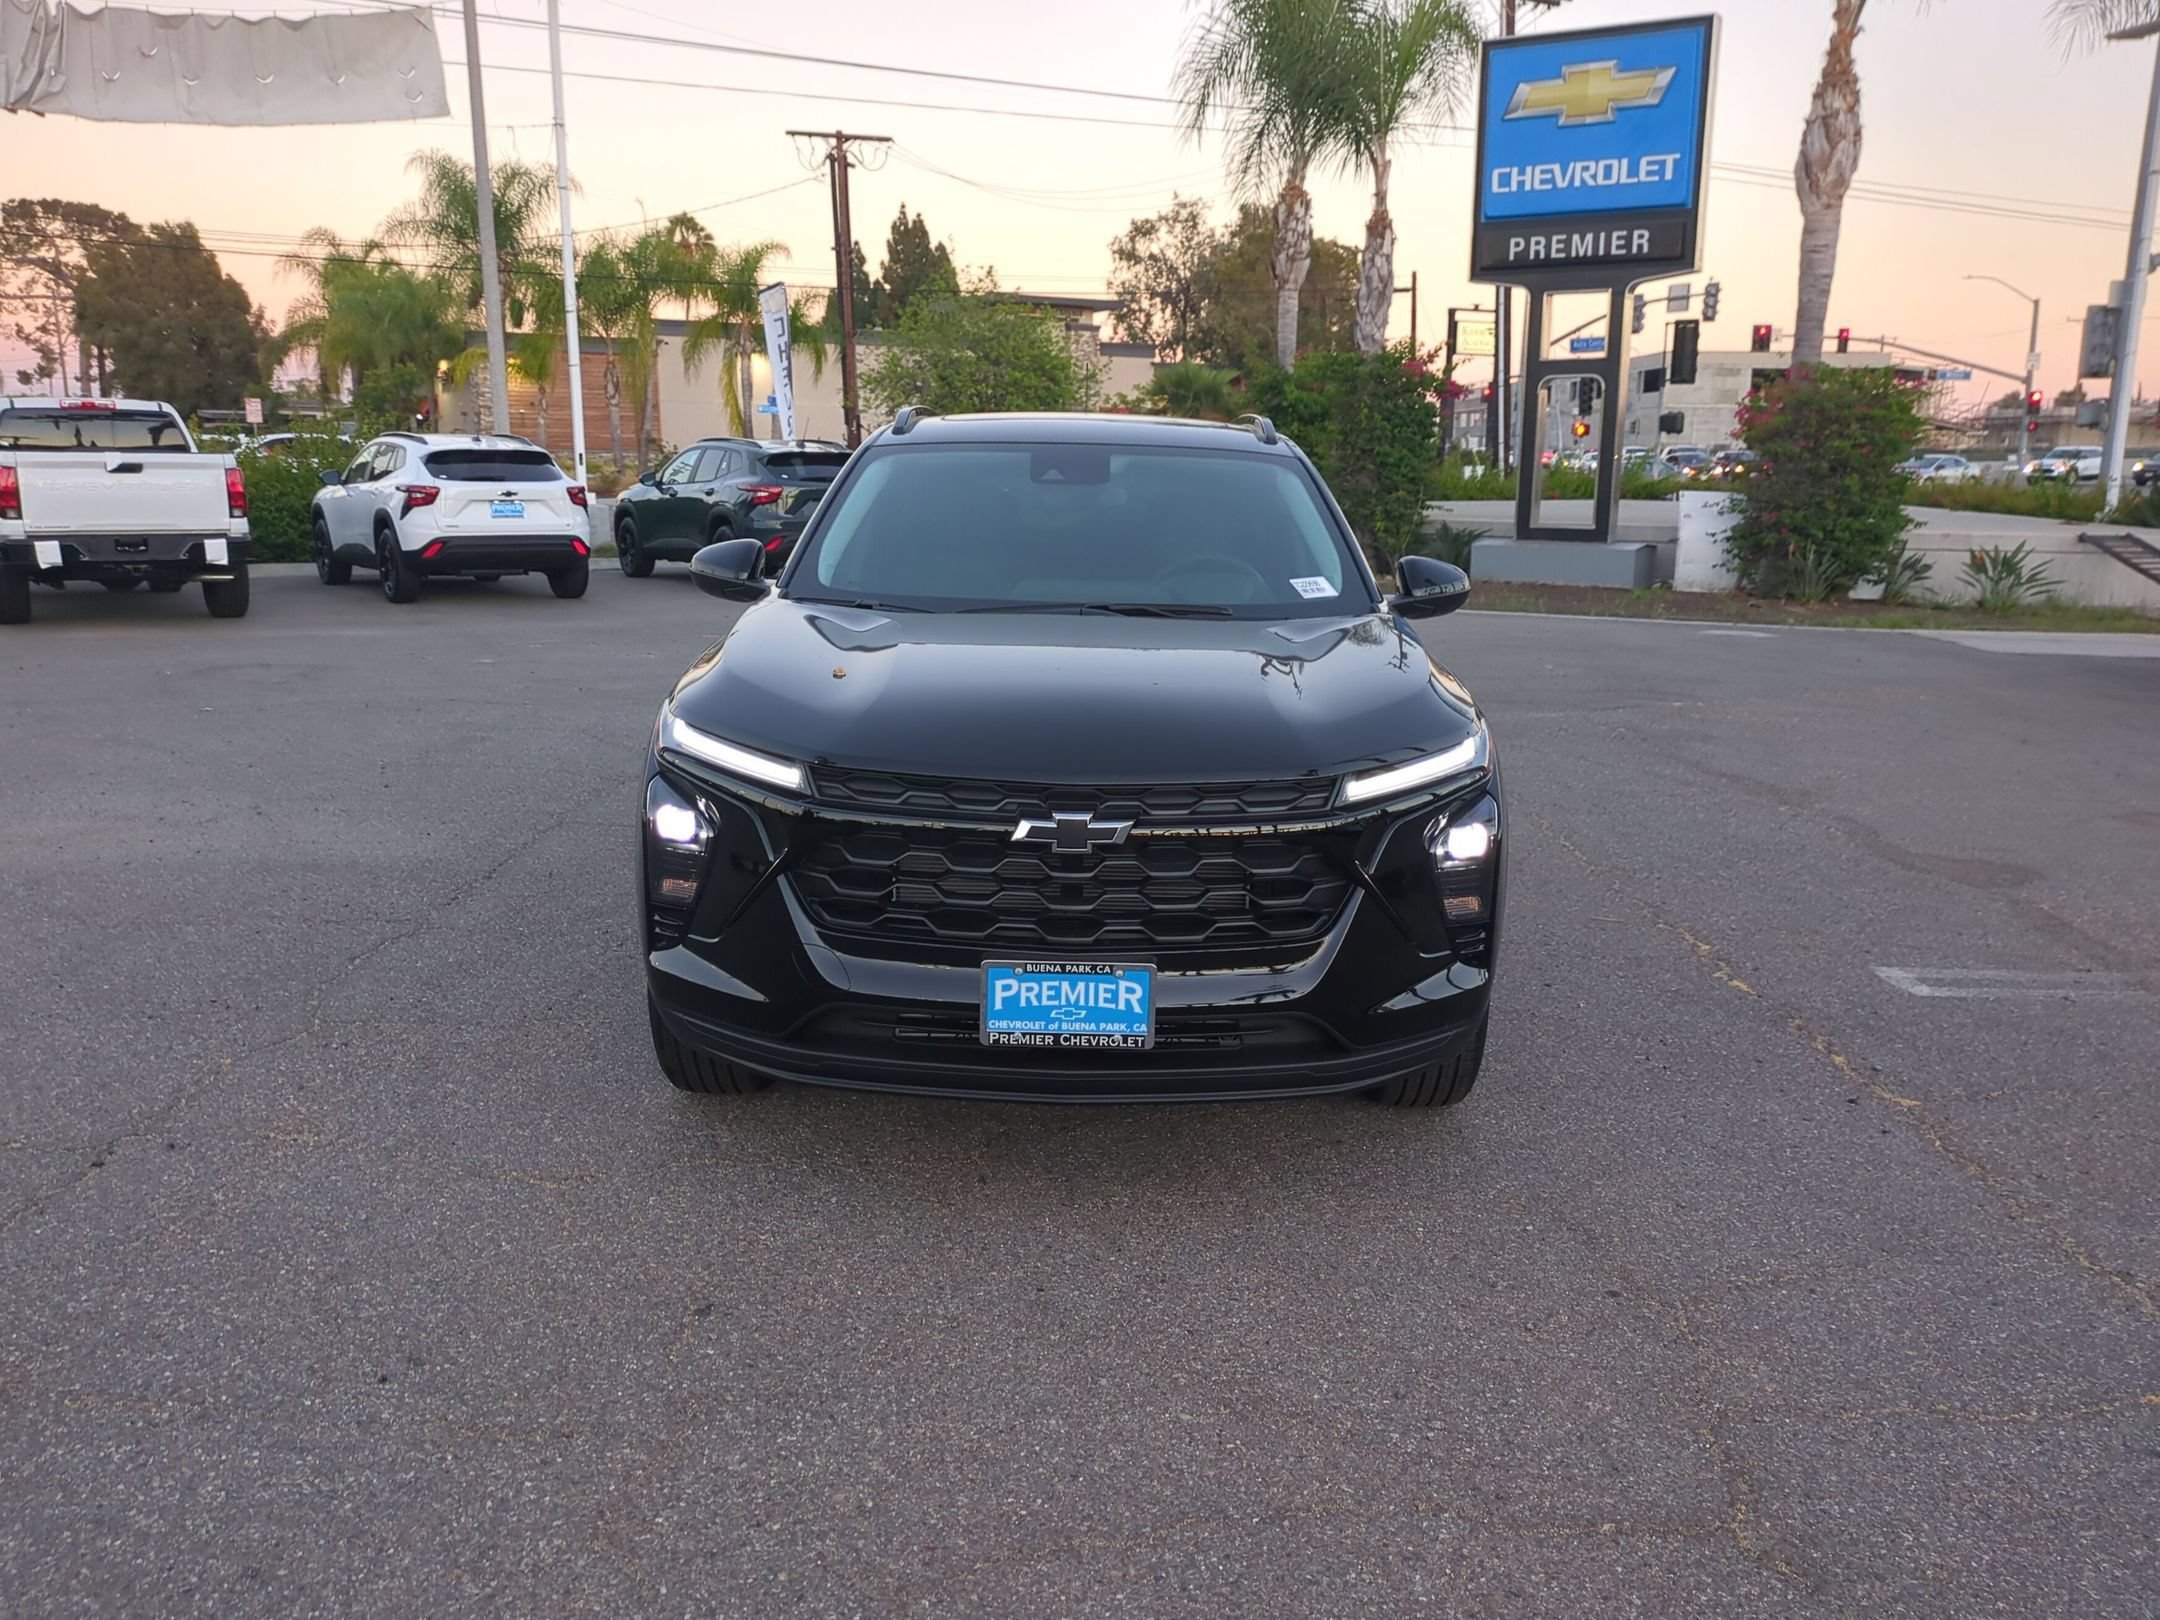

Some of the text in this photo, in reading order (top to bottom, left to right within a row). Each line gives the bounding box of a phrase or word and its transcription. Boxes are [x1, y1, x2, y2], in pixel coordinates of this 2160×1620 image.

[1491, 153, 1681, 194] CHEVROLET
[1508, 229, 1651, 261] PREMIER
[1026, 963, 1062, 973] BUENA
[994, 978, 1143, 1014] PREMIER
[988, 1020, 1148, 1032] CHEVROLET of BUENA PARK, CA
[989, 1032, 1145, 1048] PREMIER CHEVROLET
